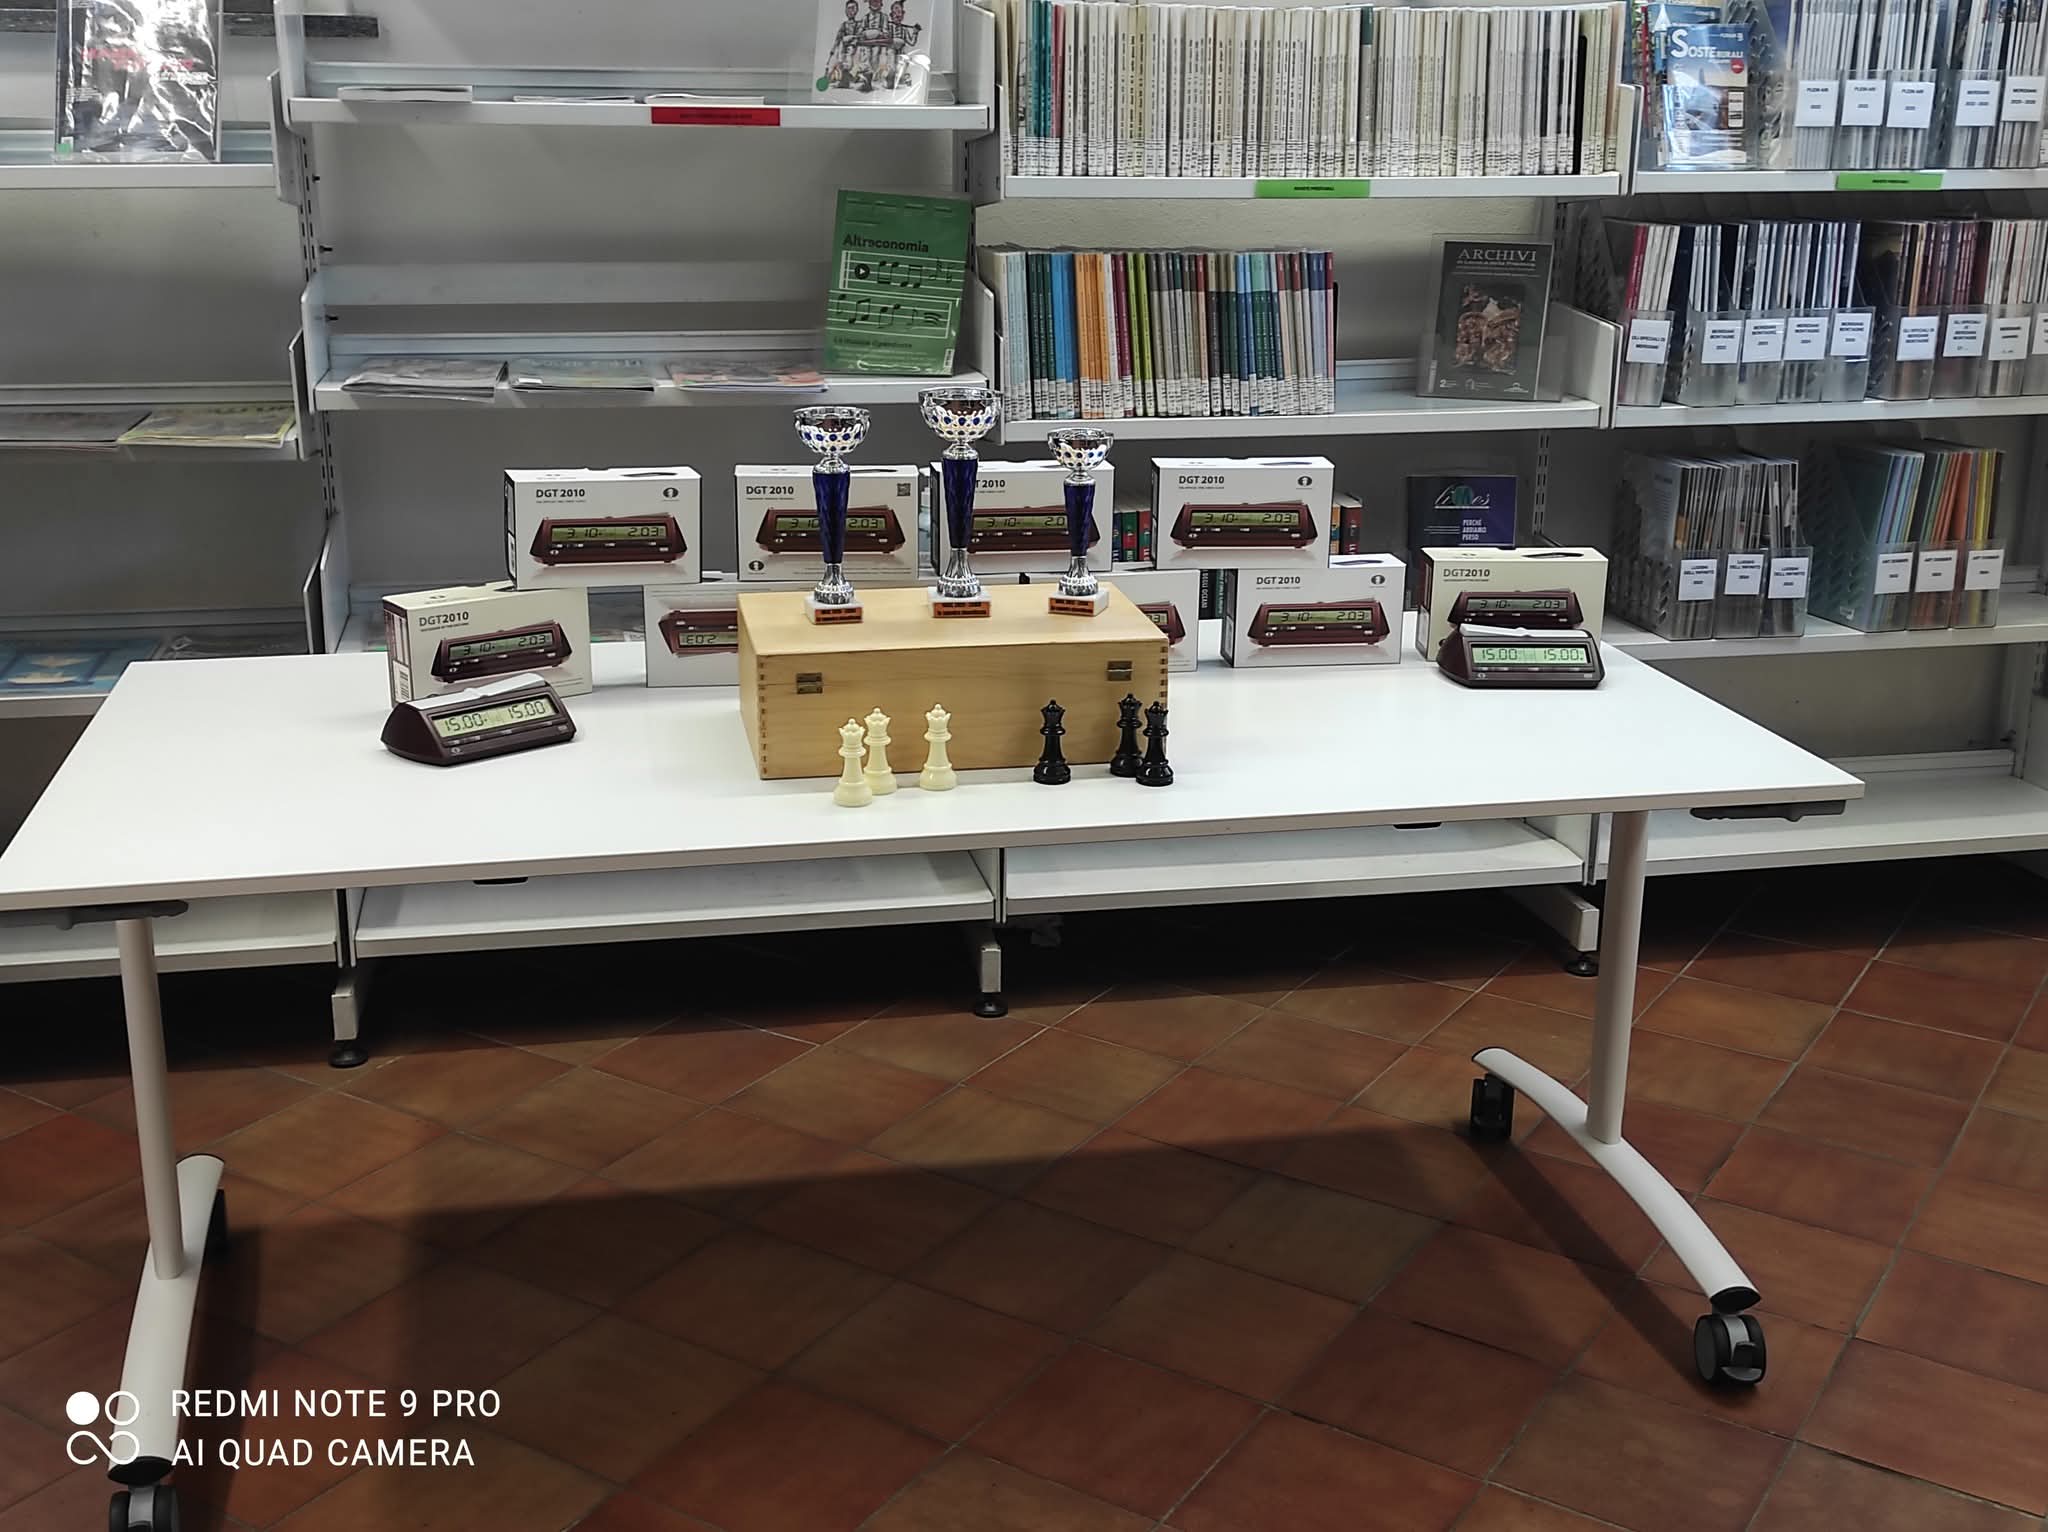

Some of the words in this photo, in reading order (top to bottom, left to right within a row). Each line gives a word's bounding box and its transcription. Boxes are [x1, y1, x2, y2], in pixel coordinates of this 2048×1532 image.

[1458, 249, 1537, 262] ARCHIVI
[982, 479, 1006, 488] 2010
[1178, 475, 1199, 485] DGT
[1201, 475, 1225, 485] 2010
[536, 489, 558, 498] DGT
[561, 489, 585, 498] 2010
[746, 486, 768, 495] DGT
[770, 486, 794, 495] 2010
[1443, 568, 1490, 577] DGT2010
[1256, 576, 1277, 585] DGT
[1278, 576, 1301, 585] 2010
[419, 611, 469, 627] DGT2010
[508, 700, 546, 719] 15.00
